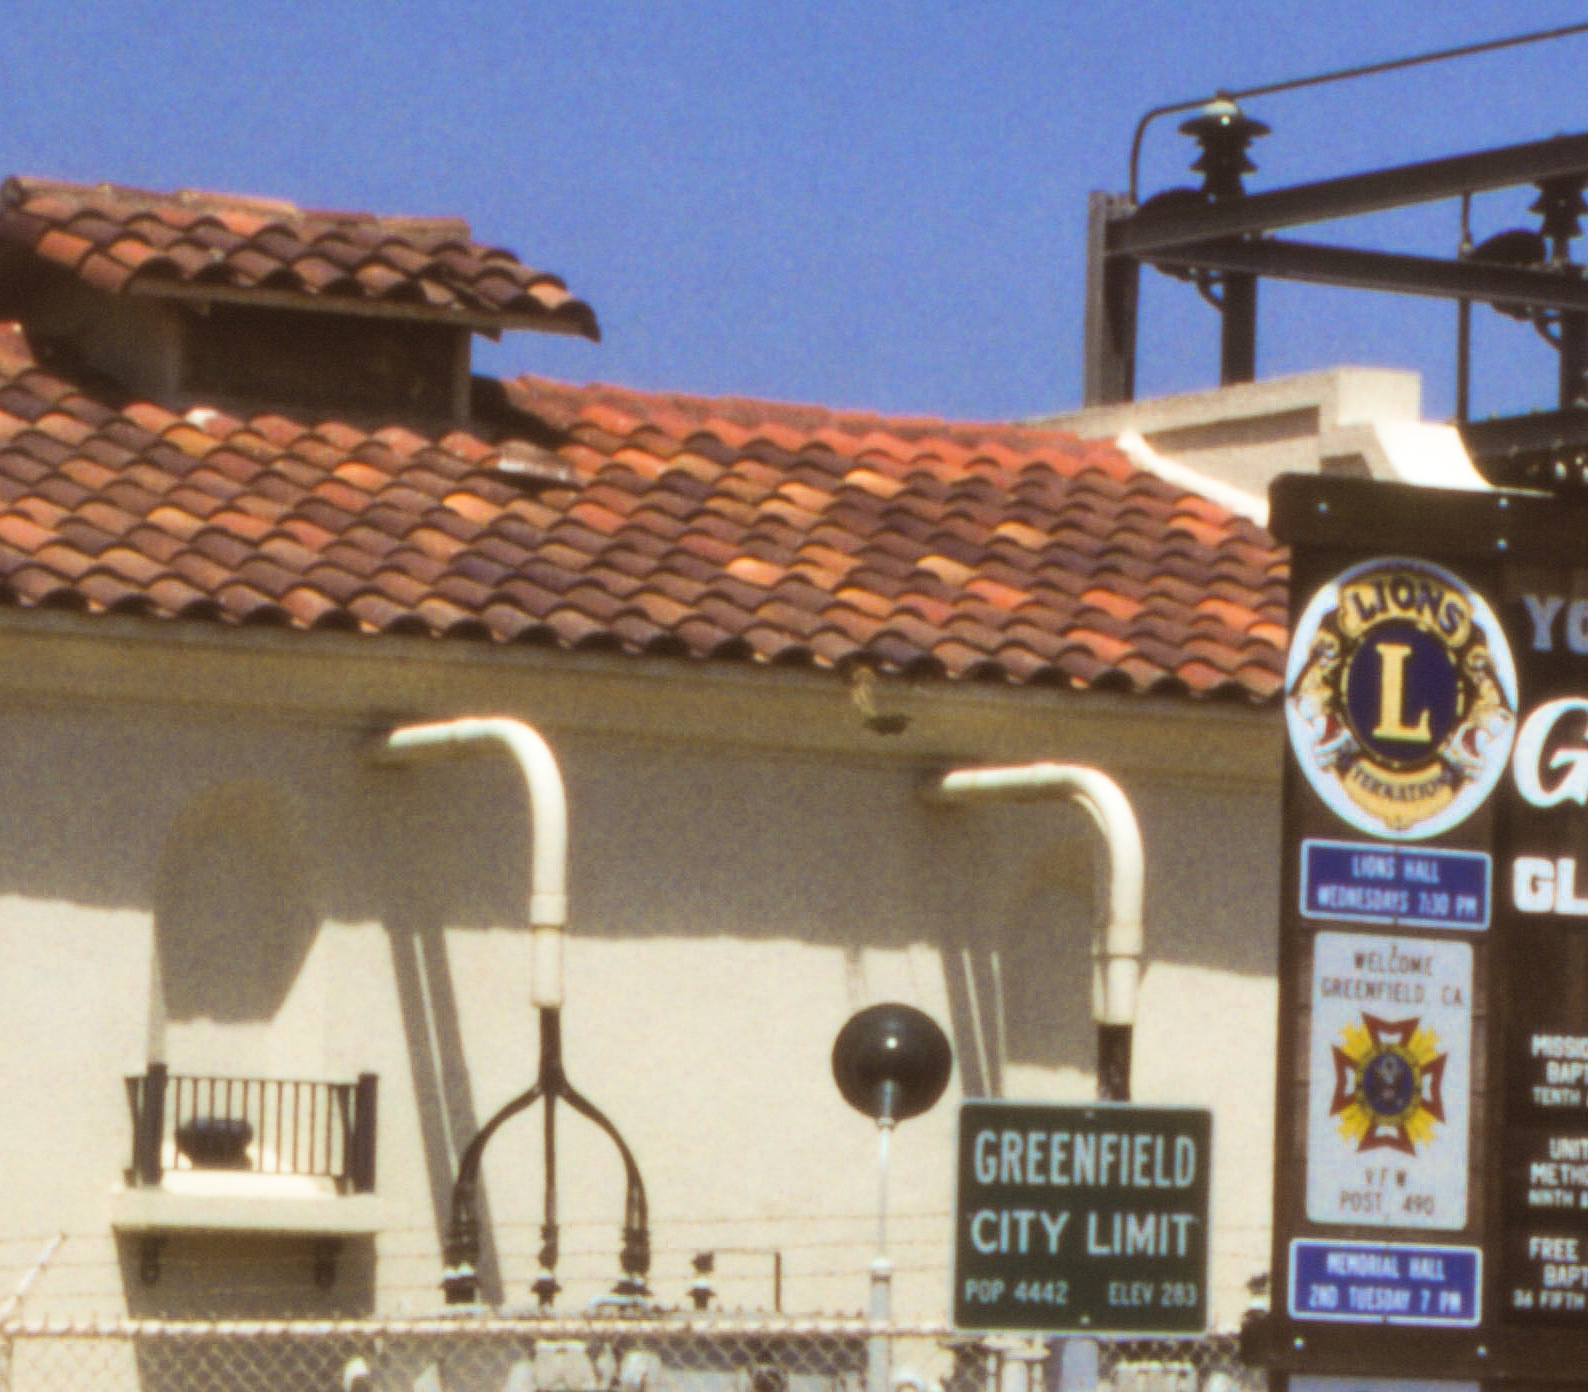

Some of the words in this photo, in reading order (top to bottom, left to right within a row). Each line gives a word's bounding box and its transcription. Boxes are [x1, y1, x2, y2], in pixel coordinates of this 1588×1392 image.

[1351, 575, 1465, 637] LIONS
[1372, 641, 1432, 744] L
[1352, 855, 1395, 881] LIONS
[1403, 859, 1440, 885] HALL
[1317, 884, 1409, 914] WEDNESDAYS
[1455, 895, 1478, 919] PM
[1354, 952, 1434, 977] WELCOME
[1533, 1086, 1582, 1107] TENTH
[973, 1129, 1196, 1188] GREENFIELD
[1340, 1190, 1383, 1213] POST
[1528, 1188, 1574, 1207] NINTH
[970, 1209, 1070, 1255] CITY
[1086, 1211, 1196, 1258] LIMIT
[1529, 1236, 1580, 1263] FREE
[1326, 1252, 1400, 1279] MEMORIAL
[1409, 1257, 1446, 1281] HALL
[965, 1278, 1005, 1304] POP
[1014, 1280, 1069, 1305] 4442
[1108, 1281, 1154, 1307] ELEV
[1309, 1284, 1338, 1308] 2ND
[1349, 1286, 1411, 1313] TUESDAY
[1420, 1289, 1431, 1313] 7
[1439, 1290, 1461, 1314] PM
[1540, 1290, 1586, 1311] FIFTH
